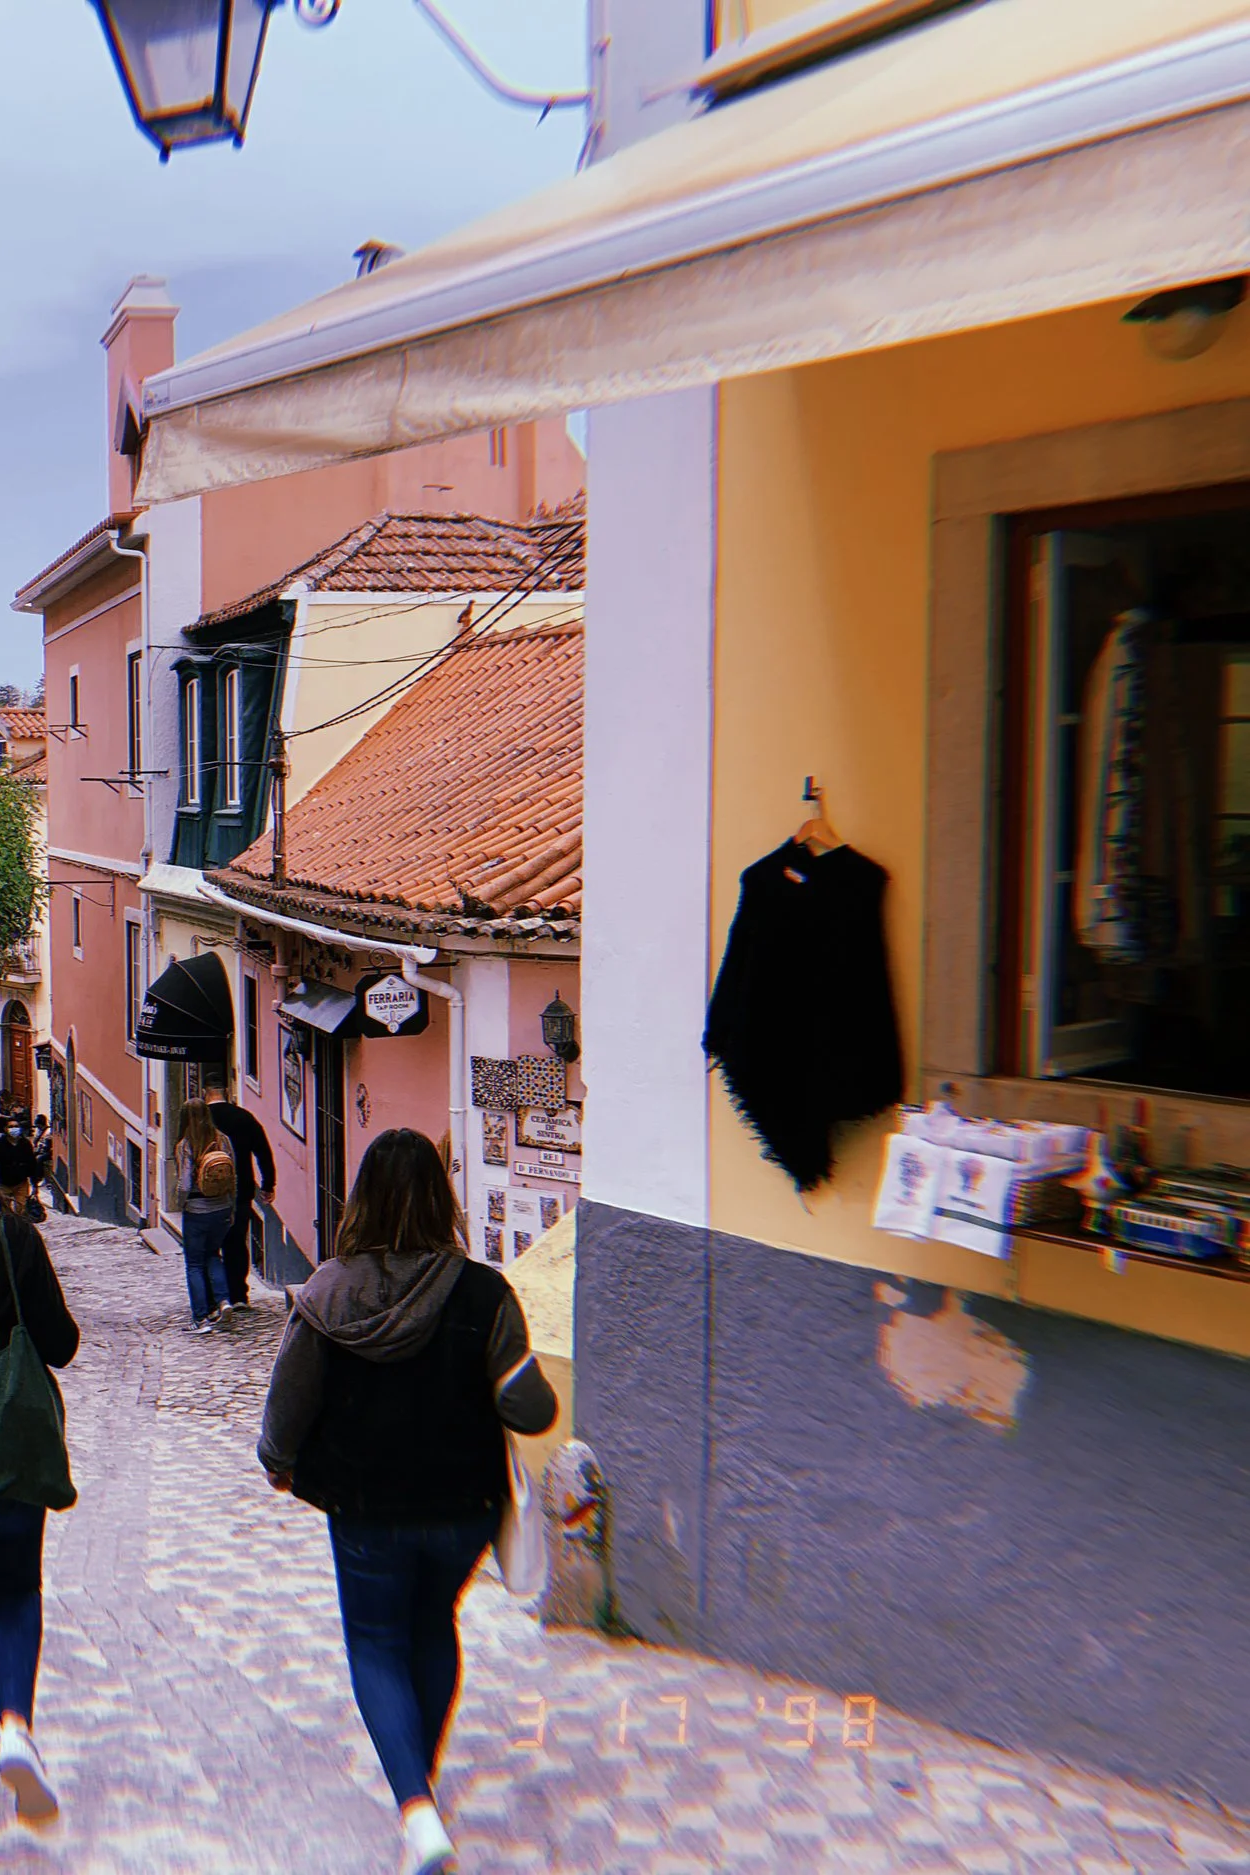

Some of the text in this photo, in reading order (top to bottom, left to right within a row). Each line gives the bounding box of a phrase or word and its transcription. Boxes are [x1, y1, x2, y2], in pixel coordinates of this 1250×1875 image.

[368, 992, 415, 1004] FERRARIA
[536, 1130, 566, 1140] SINTRA
[543, 1153, 558, 1161] REI
[528, 1166, 570, 1178] FERNANDO
